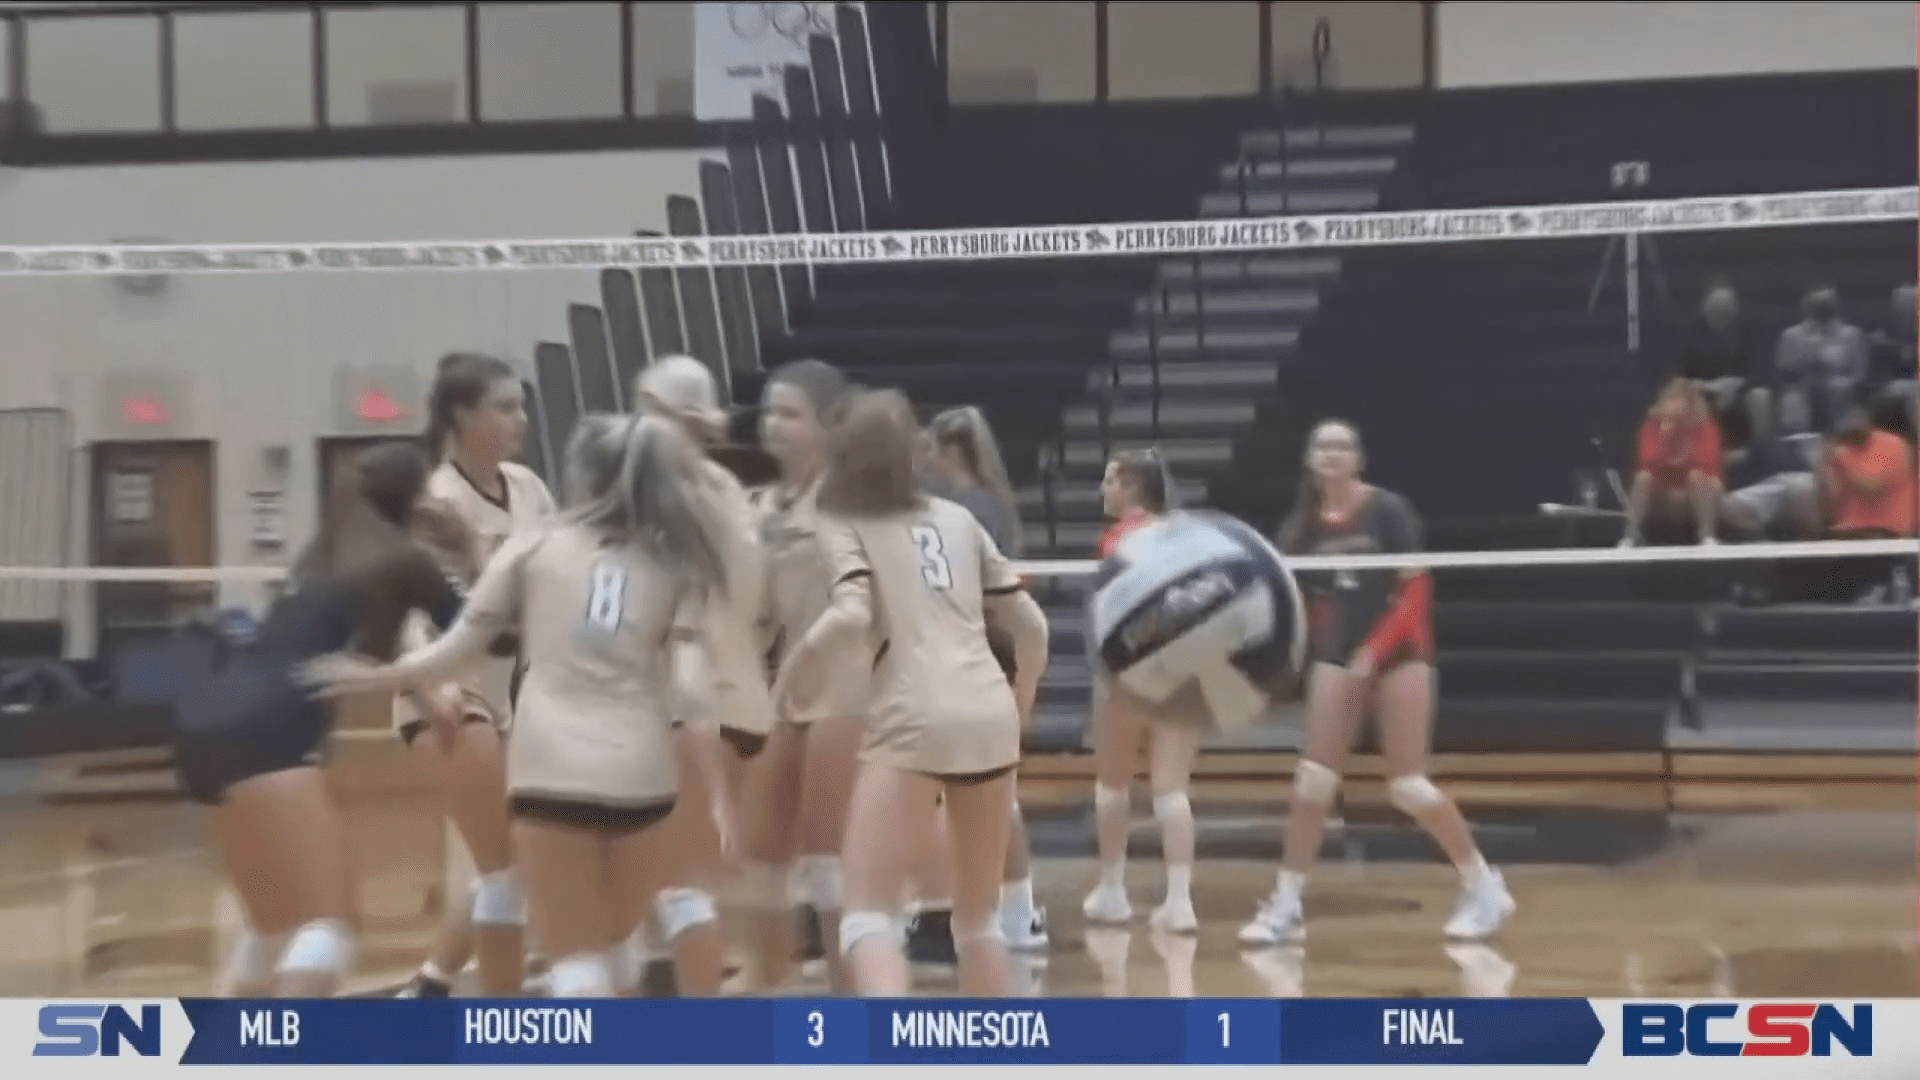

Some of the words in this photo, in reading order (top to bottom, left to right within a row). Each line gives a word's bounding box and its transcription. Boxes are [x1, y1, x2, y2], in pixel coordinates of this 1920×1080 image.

[910, 233, 1009, 257] PERRYSBURG
[1013, 229, 1081, 252] JACKETS
[1116, 226, 1216, 249] PERRYSBURG
[1220, 222, 1290, 246] JACKETS
[911, 521, 953, 590] 3
[587, 562, 626, 631] 8
